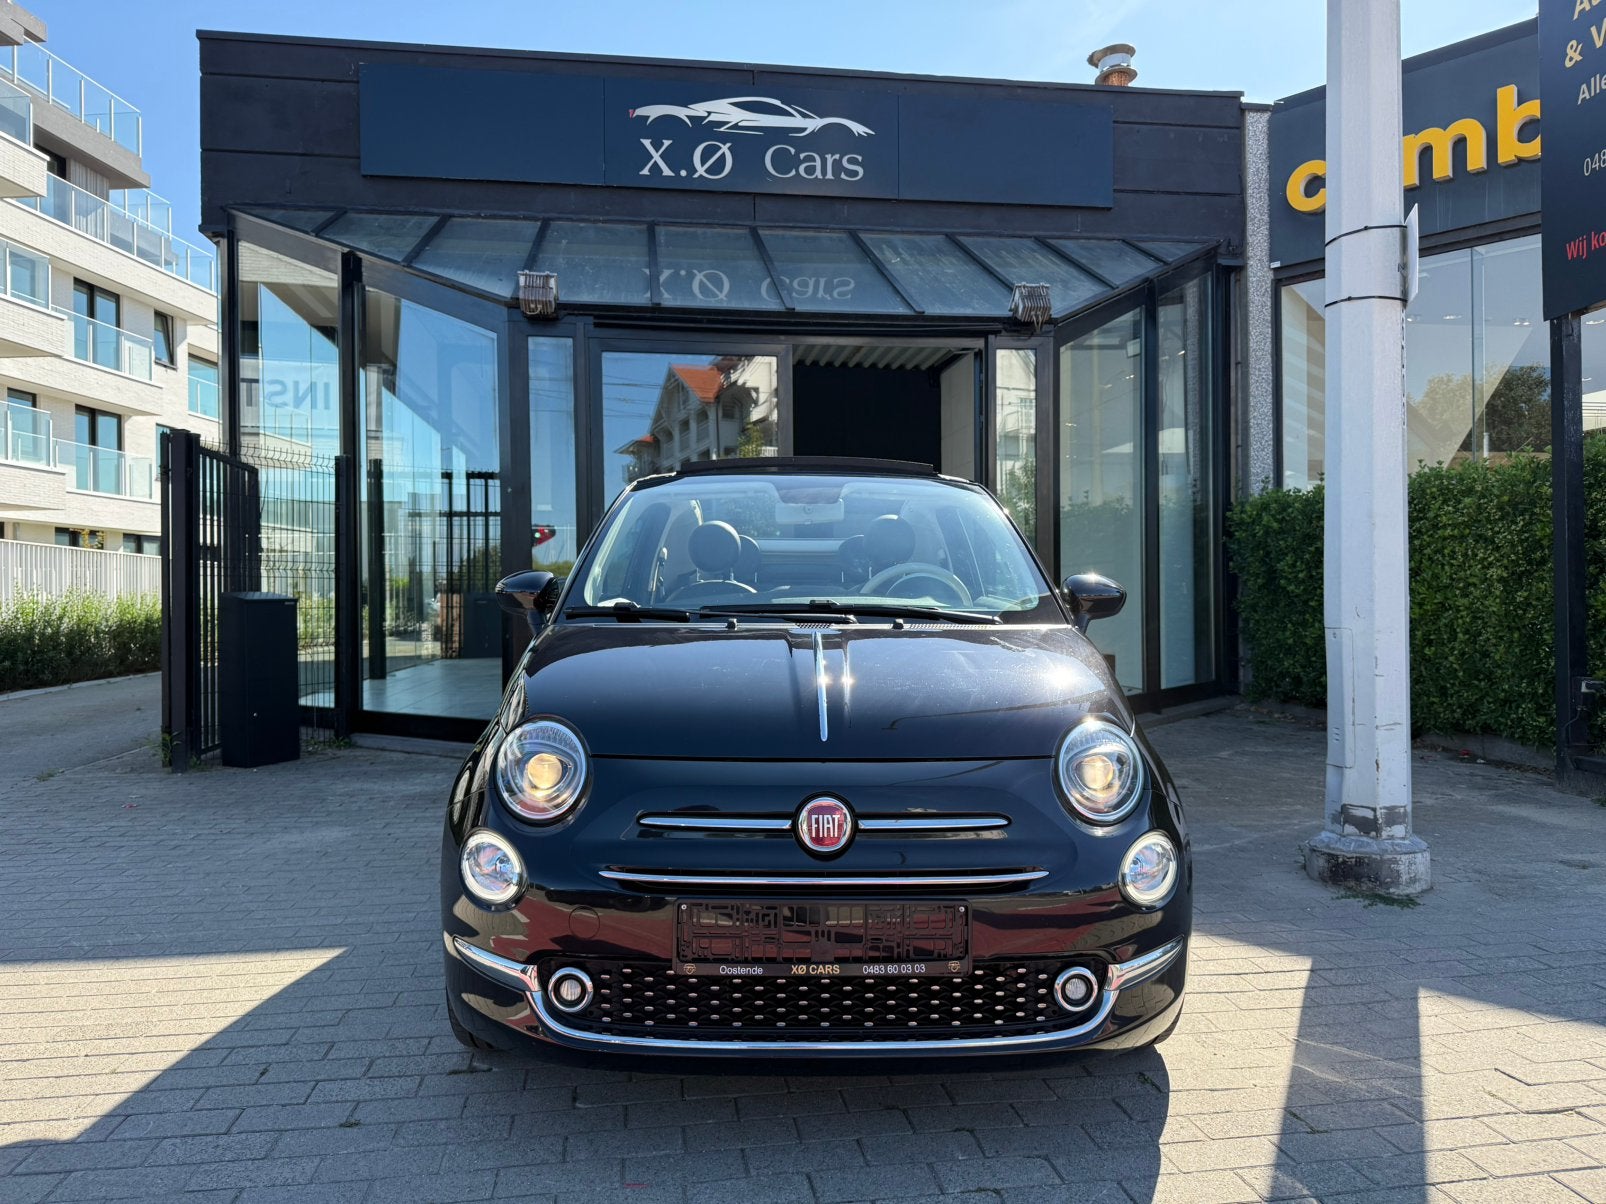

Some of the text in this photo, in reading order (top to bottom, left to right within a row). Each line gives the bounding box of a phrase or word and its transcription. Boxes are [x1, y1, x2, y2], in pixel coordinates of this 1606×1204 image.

[1564, 39, 1583, 68] &
[764, 144, 864, 181] Cars
[1566, 235, 1587, 260] Wij
[811, 814, 840, 838] FIAT
[719, 965, 763, 975] Oostende
[809, 964, 840, 975] CARS
[862, 963, 926, 974] 0483 60 03 03
